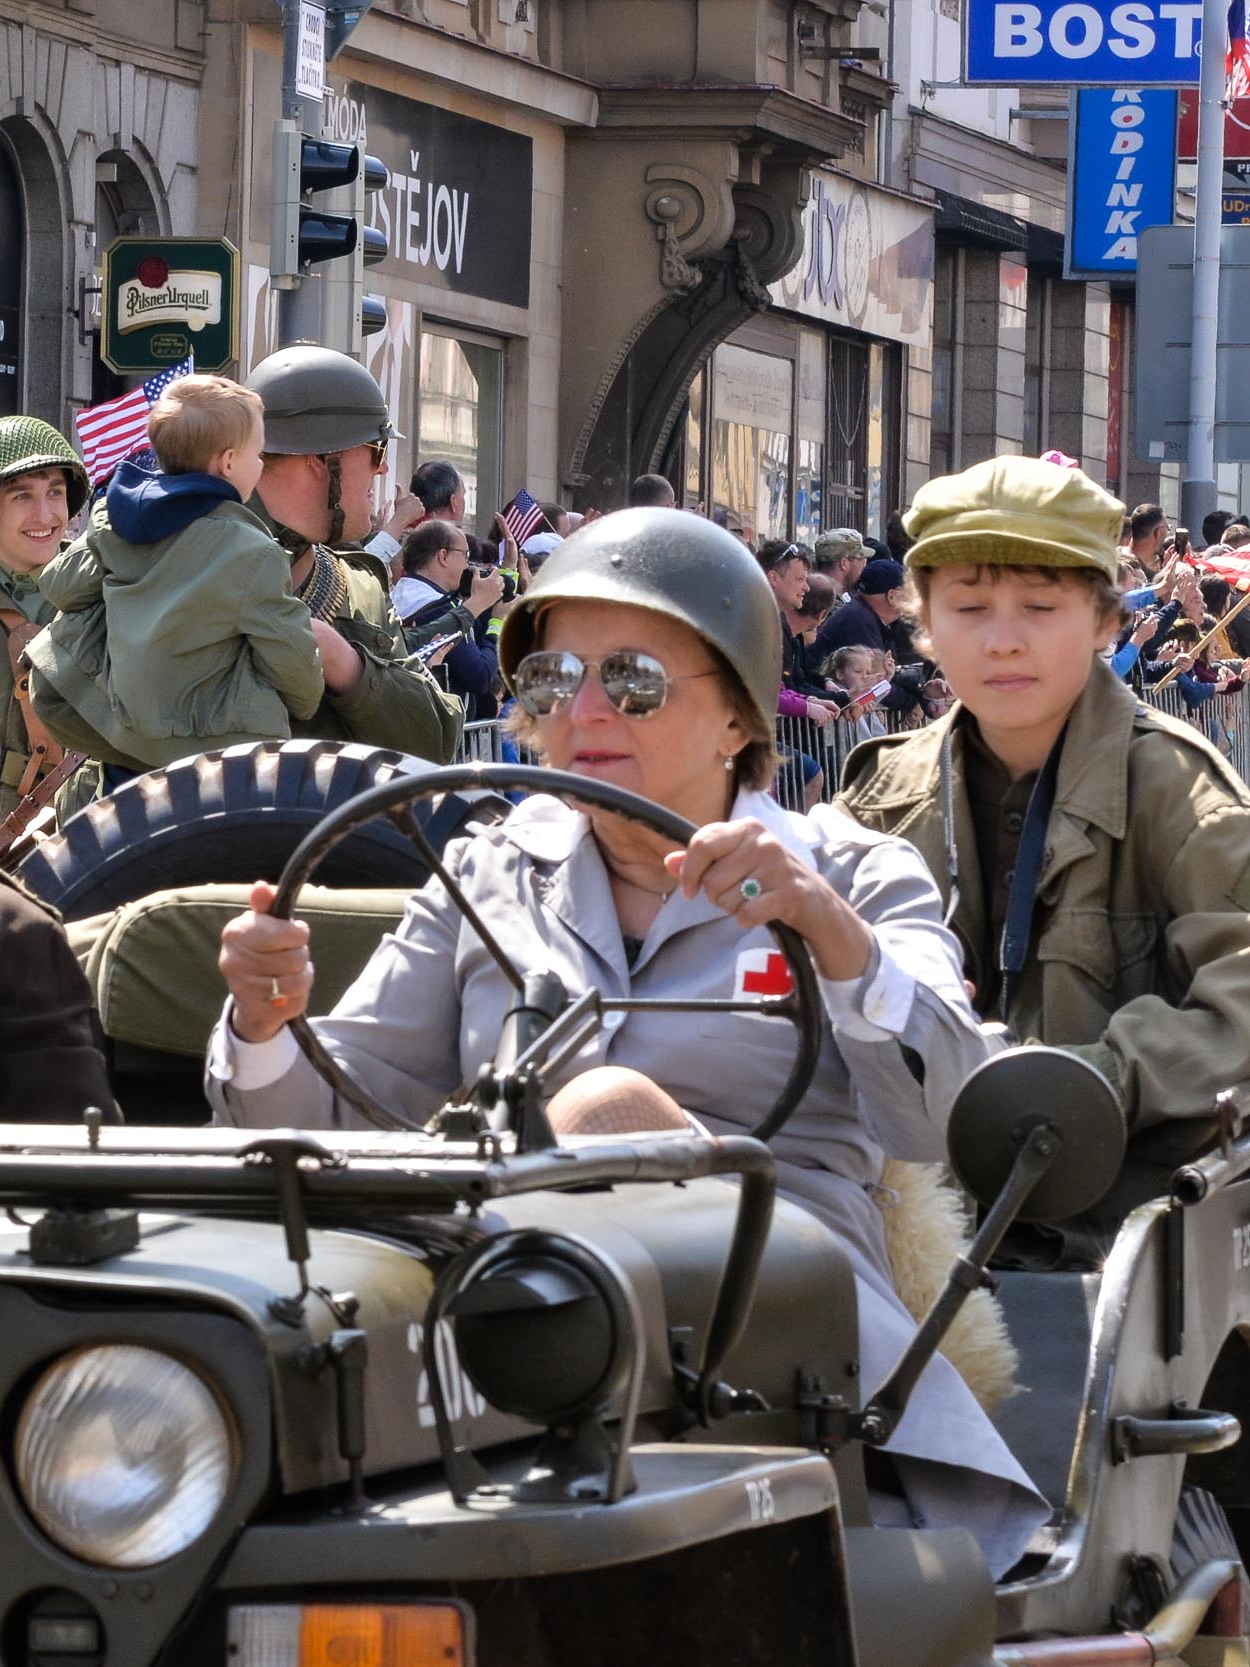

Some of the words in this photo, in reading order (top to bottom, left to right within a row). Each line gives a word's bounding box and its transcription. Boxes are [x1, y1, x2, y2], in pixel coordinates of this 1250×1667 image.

[993, 3, 1201, 60] BOST
[126, 286, 168, 317] Pilsner
[167, 285, 210, 311] Urquell
